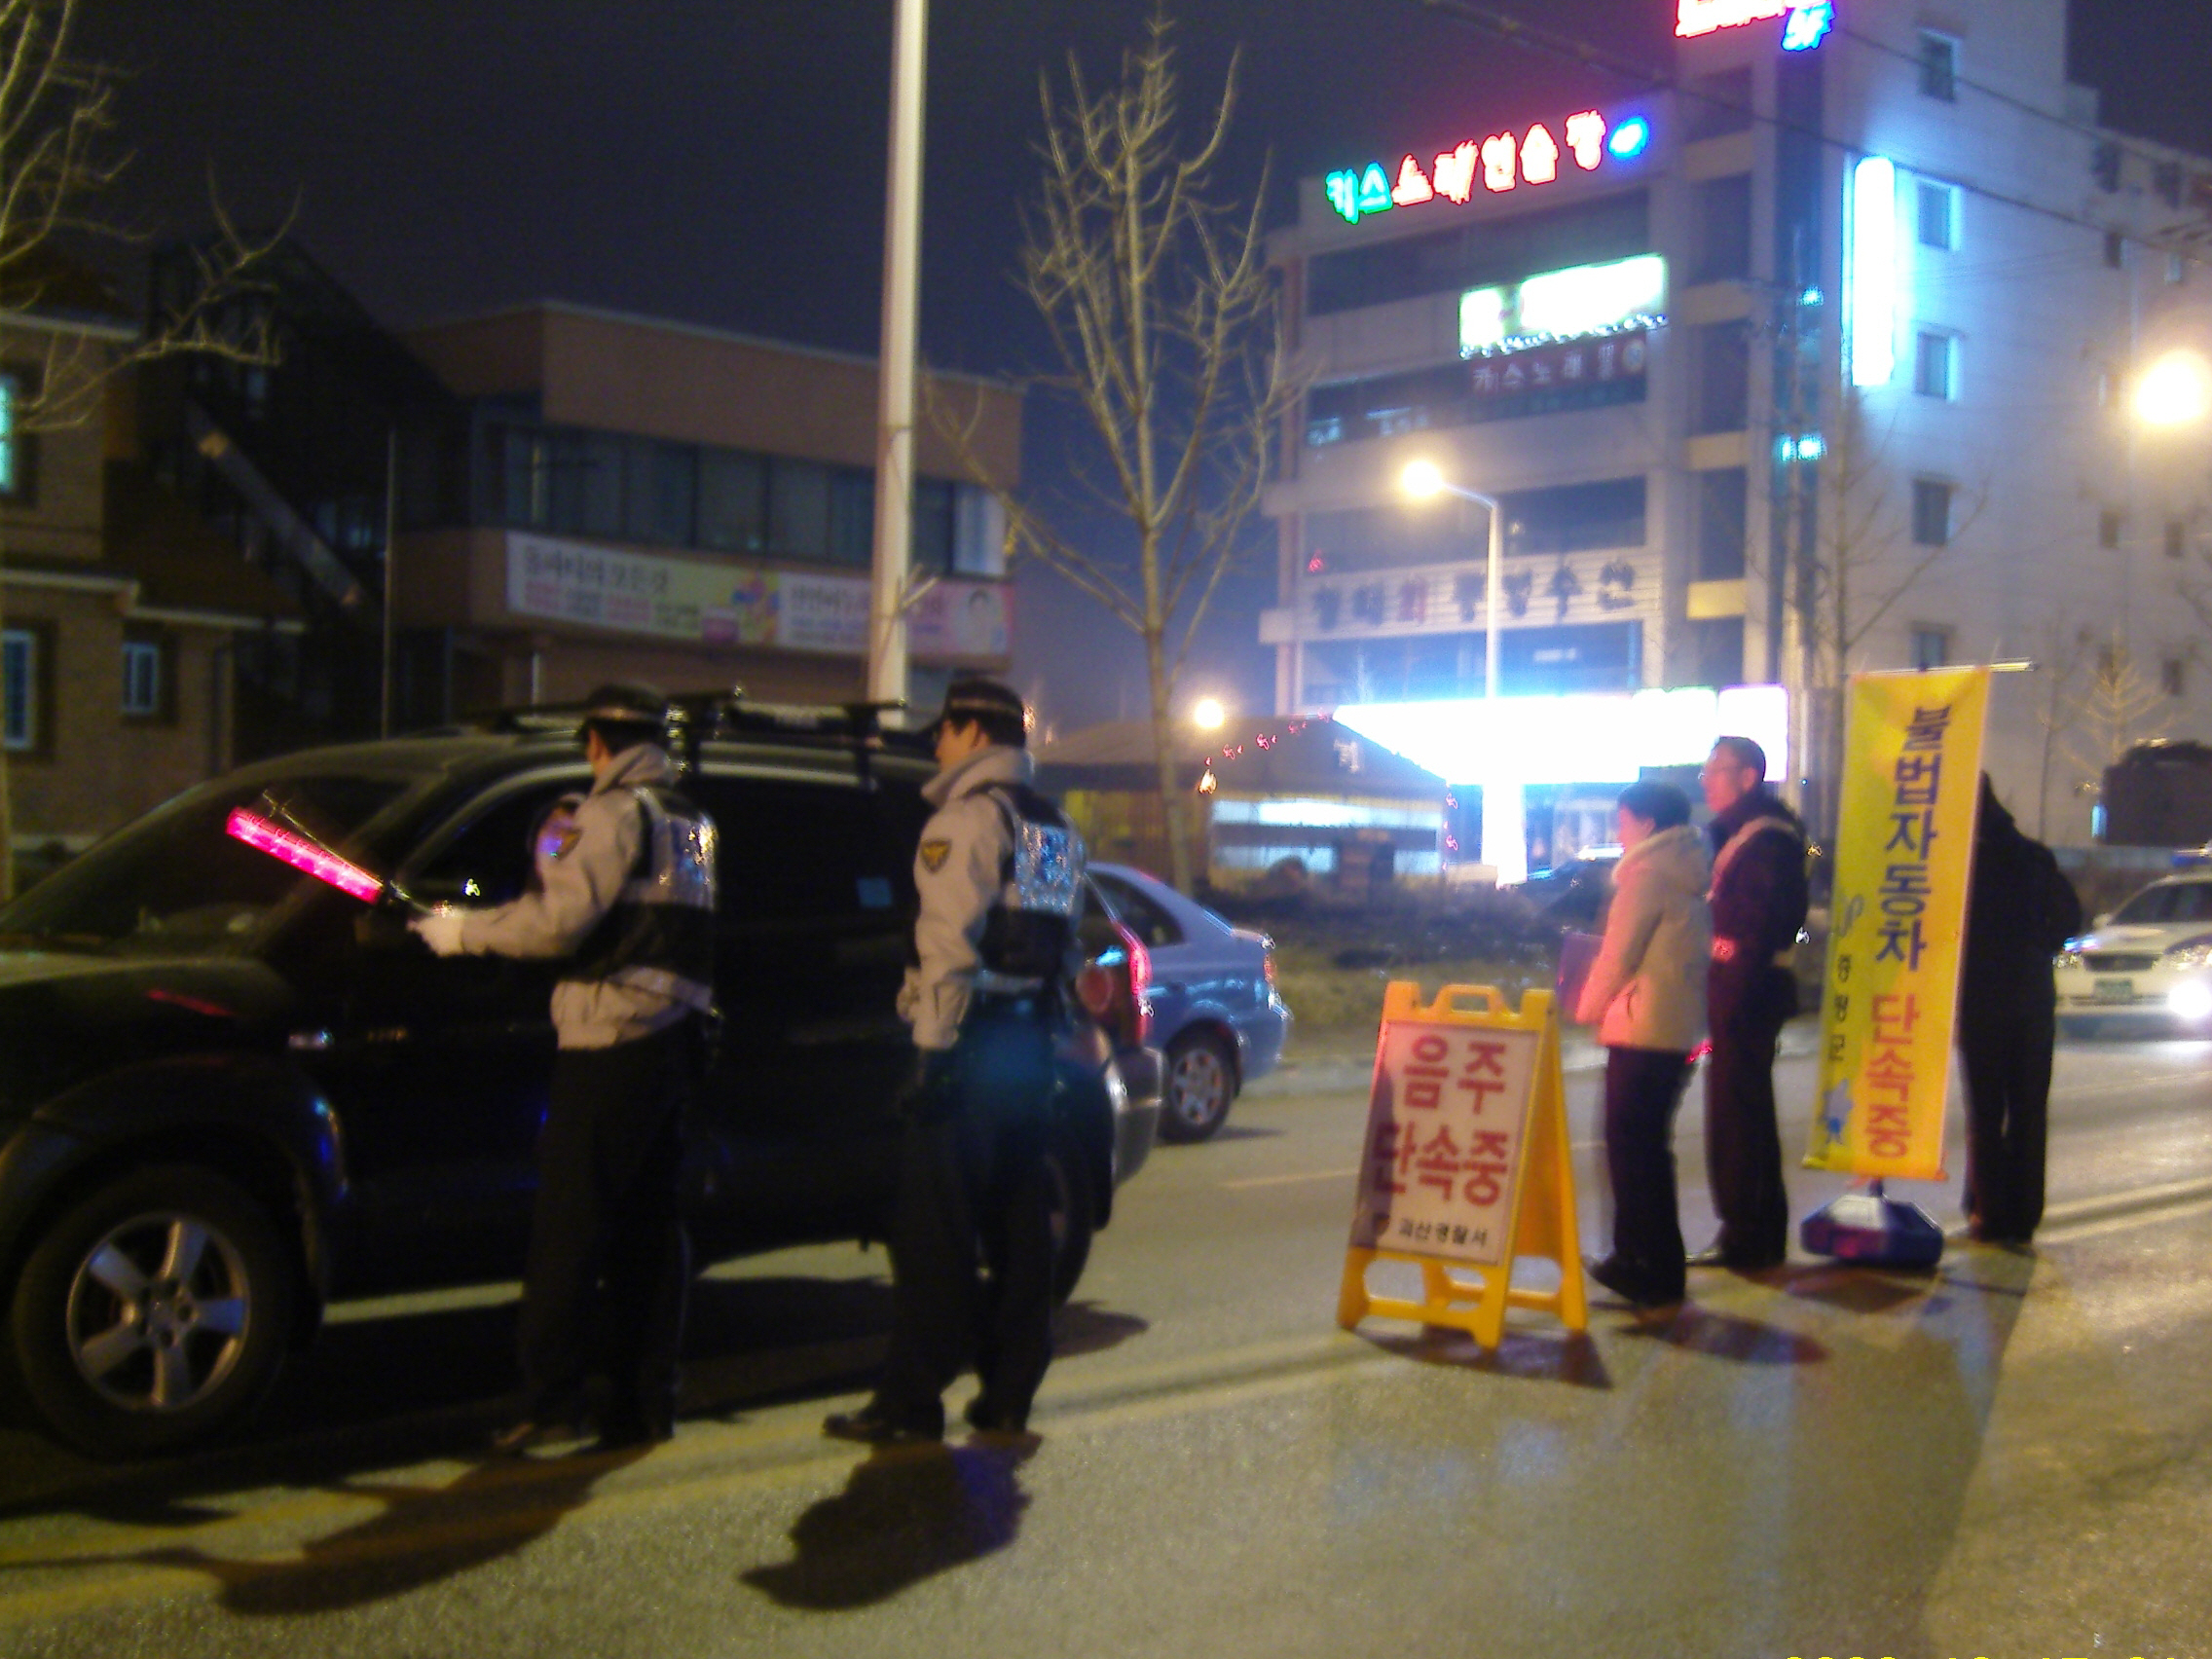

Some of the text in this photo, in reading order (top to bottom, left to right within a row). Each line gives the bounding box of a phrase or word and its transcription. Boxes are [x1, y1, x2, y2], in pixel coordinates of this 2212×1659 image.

[1864, 705, 1951, 1159] 불법자동차 단속중
[1403, 1034, 1507, 1115] 음주
[1372, 1121, 1508, 1206] 단속중
